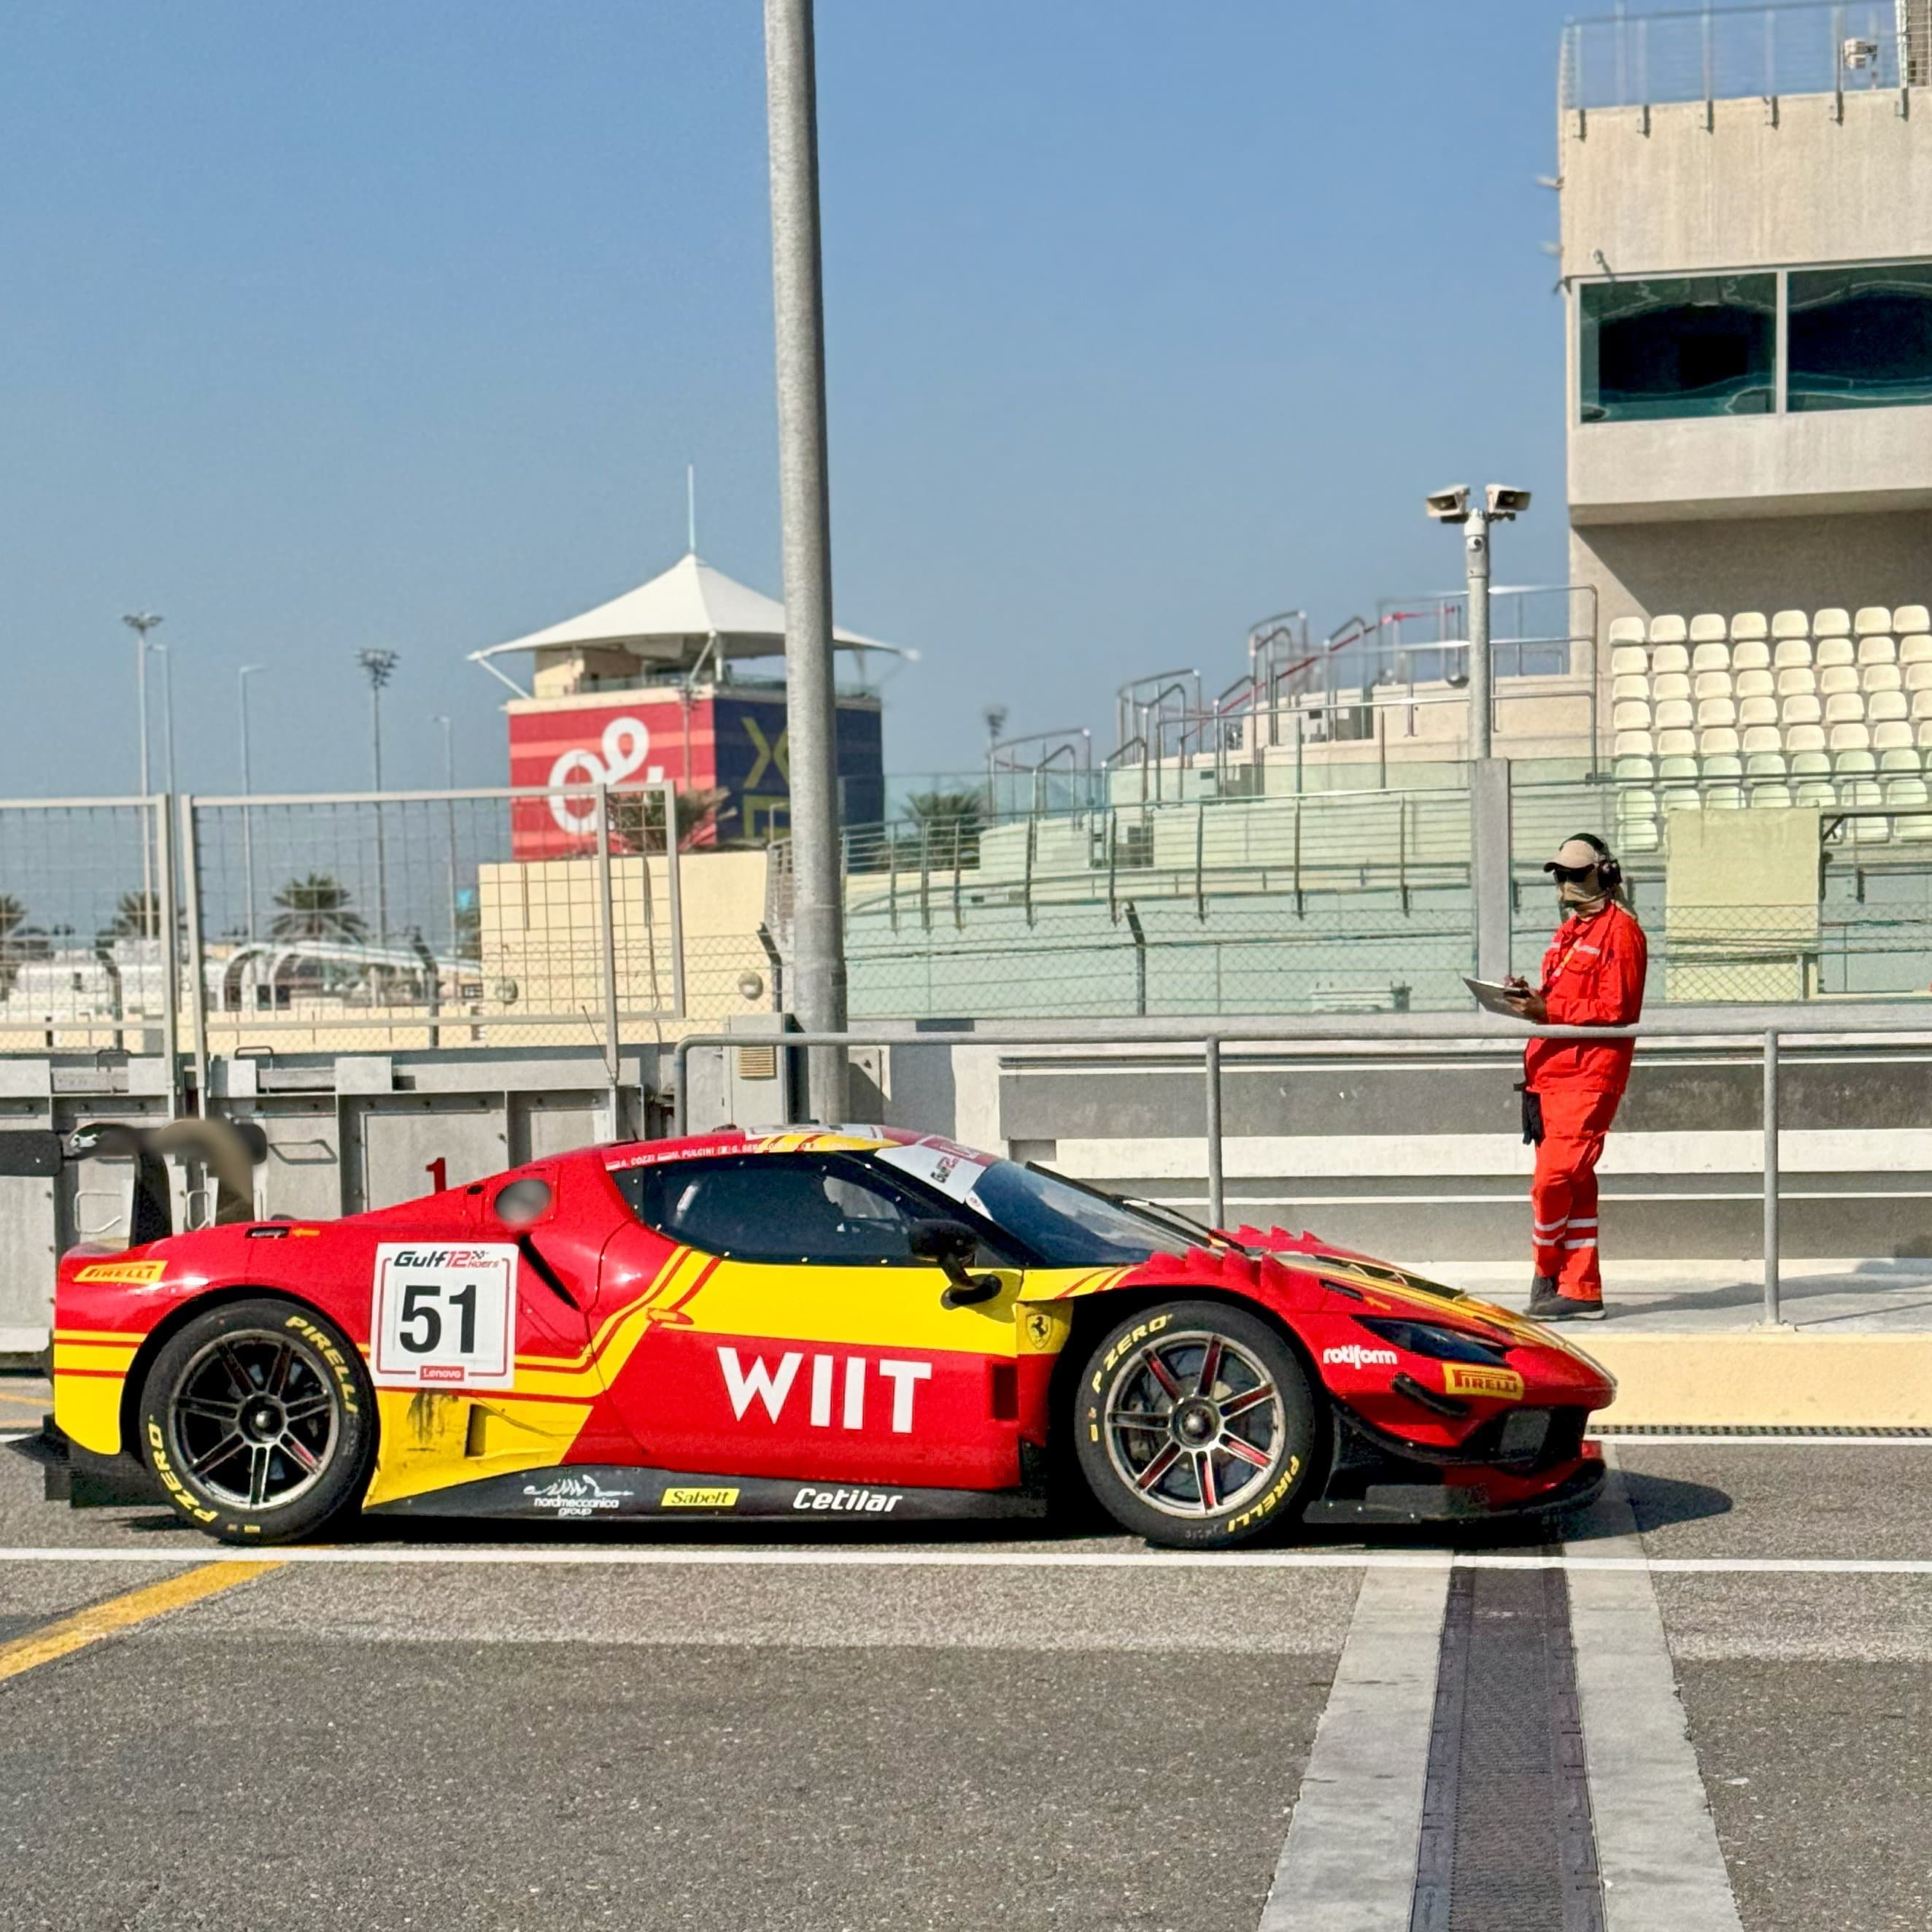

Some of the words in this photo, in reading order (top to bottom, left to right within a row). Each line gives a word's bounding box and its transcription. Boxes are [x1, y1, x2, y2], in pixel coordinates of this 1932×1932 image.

[400, 1284, 476, 1353] 51
[1104, 1314, 1167, 1371] ZERO
[1323, 1345, 1397, 1369] rotiform
[285, 1315, 358, 1413] PIRELLI
[423, 1368, 461, 1378] Lenovo
[1453, 1369, 1518, 1393] PIRELLI
[716, 1346, 932, 1434] WIIT
[148, 1423, 200, 1510] ZERO
[534, 1498, 619, 1508] nordmeccanica
[558, 1507, 592, 1516] group
[793, 1488, 903, 1512] Cetilar
[1227, 1455, 1299, 1532] PIRELLI
